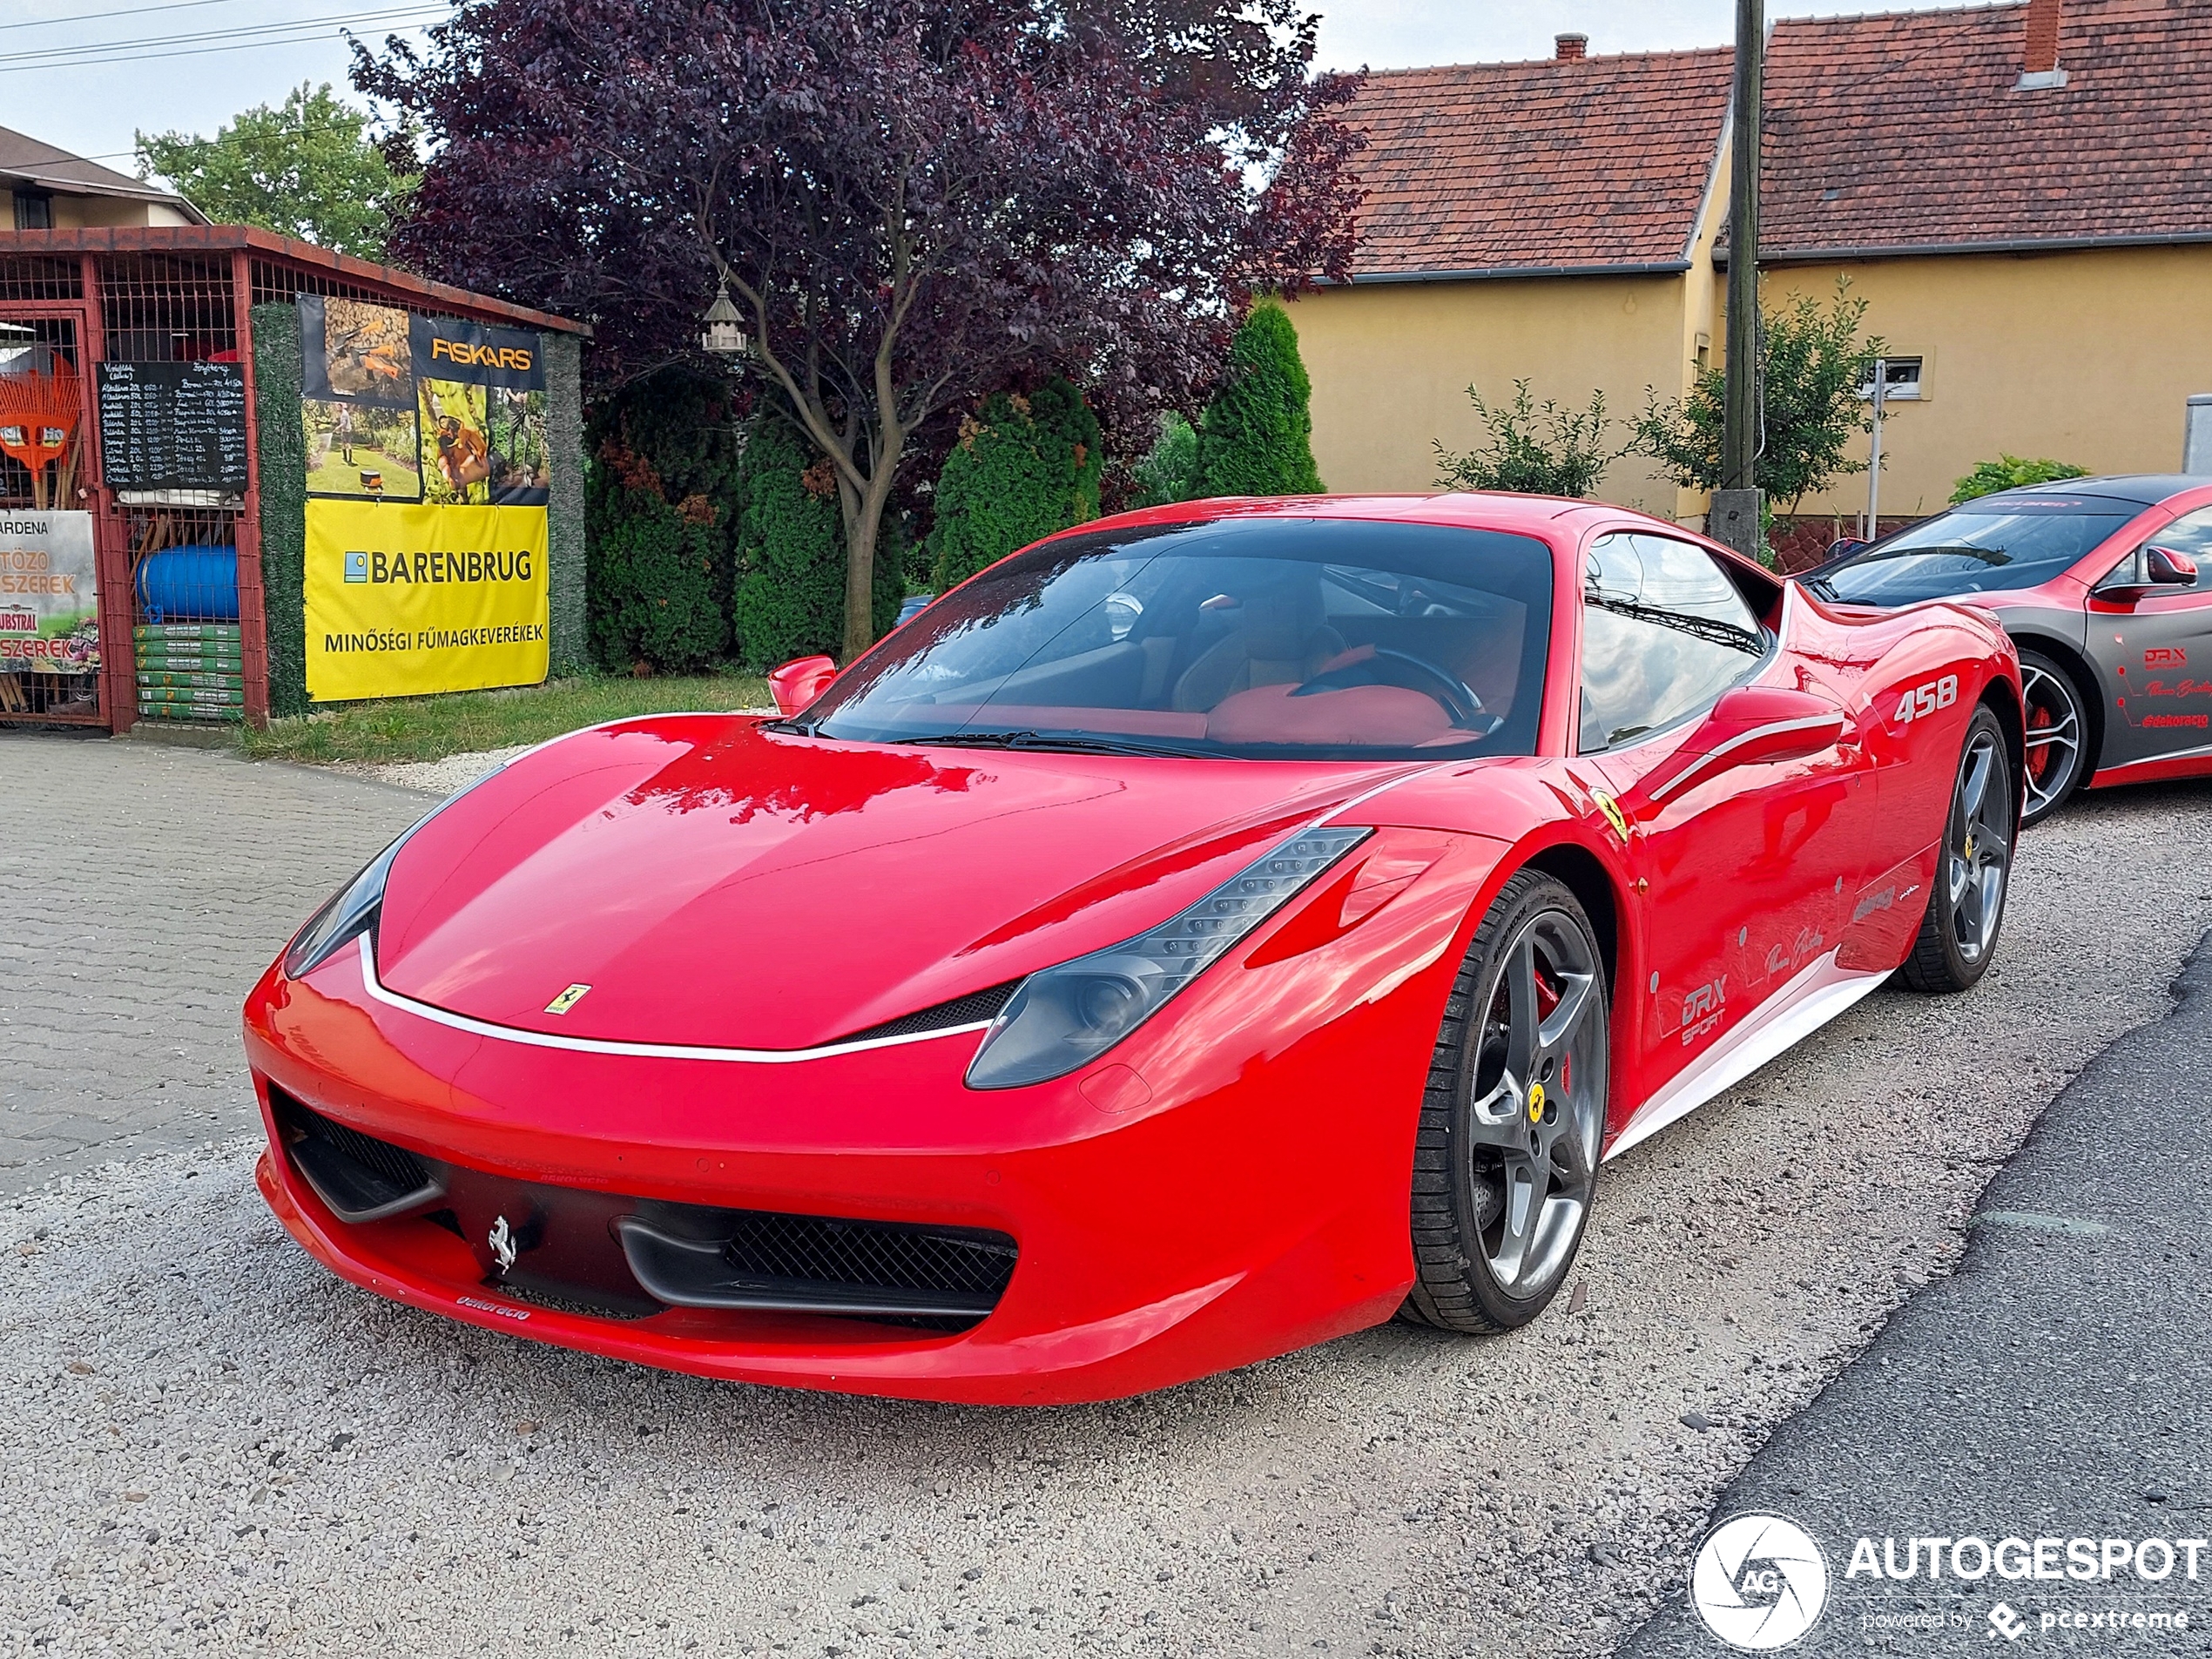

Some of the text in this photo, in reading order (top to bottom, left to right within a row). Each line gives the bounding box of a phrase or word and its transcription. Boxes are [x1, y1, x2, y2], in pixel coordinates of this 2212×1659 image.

[372, 550, 532, 583] BARENBRUG
[2, 575, 75, 594] SZEREK
[0, 639, 73, 658] SZEREK
[324, 621, 543, 653] MINŐSÉGI FŰMAGKEVERÉKEK
[1893, 674, 1958, 724] 458
[1682, 1008, 1725, 1046] SPORT
